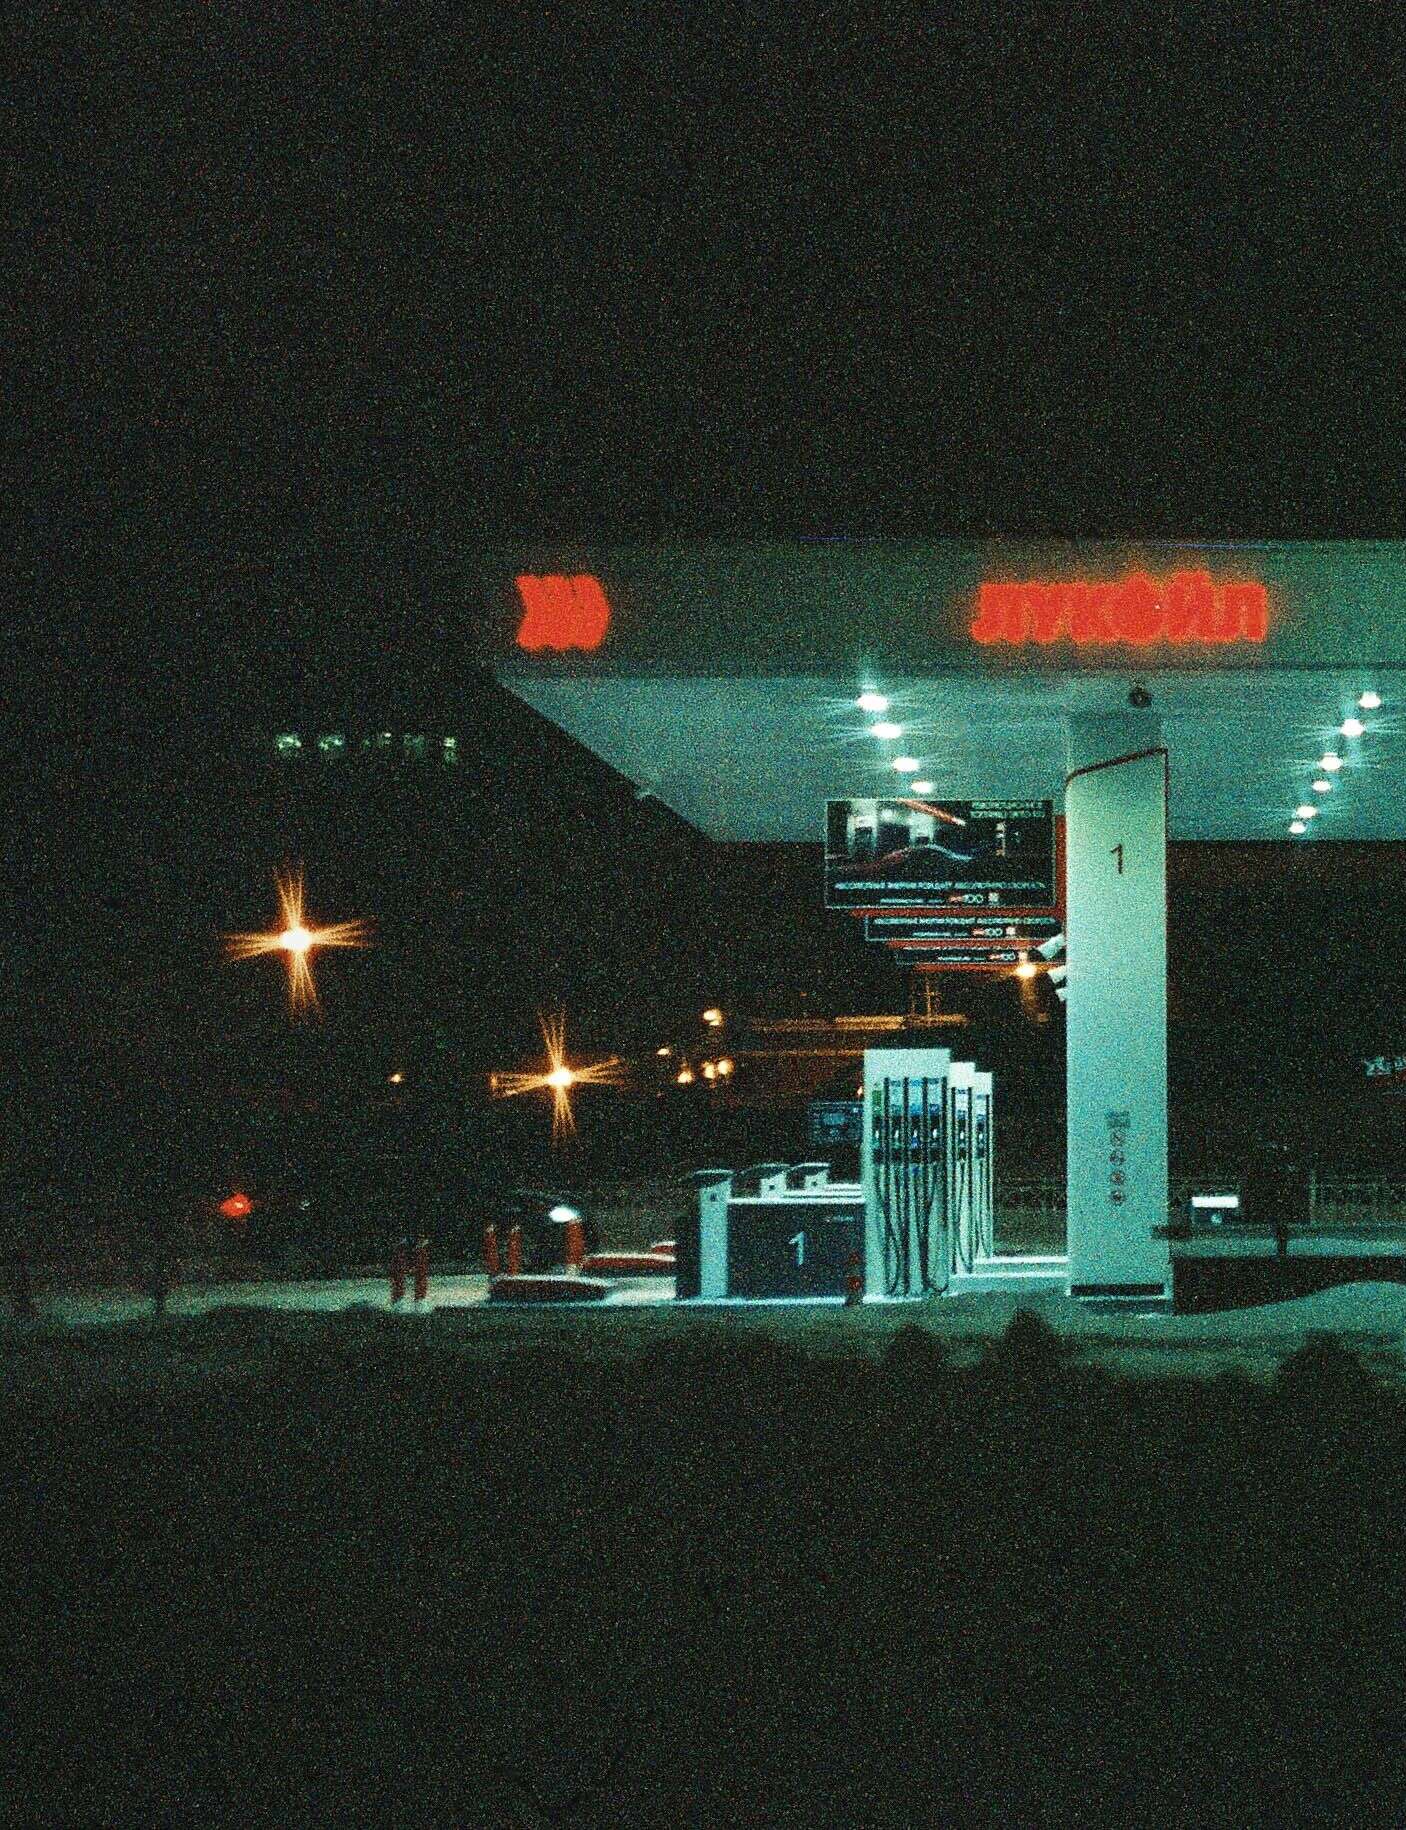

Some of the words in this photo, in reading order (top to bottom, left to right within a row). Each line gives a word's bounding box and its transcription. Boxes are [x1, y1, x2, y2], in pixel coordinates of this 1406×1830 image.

[969, 568, 1268, 645] ЛУКОЙЛ
[1109, 842, 1124, 875] 1
[788, 1230, 805, 1266] 1
